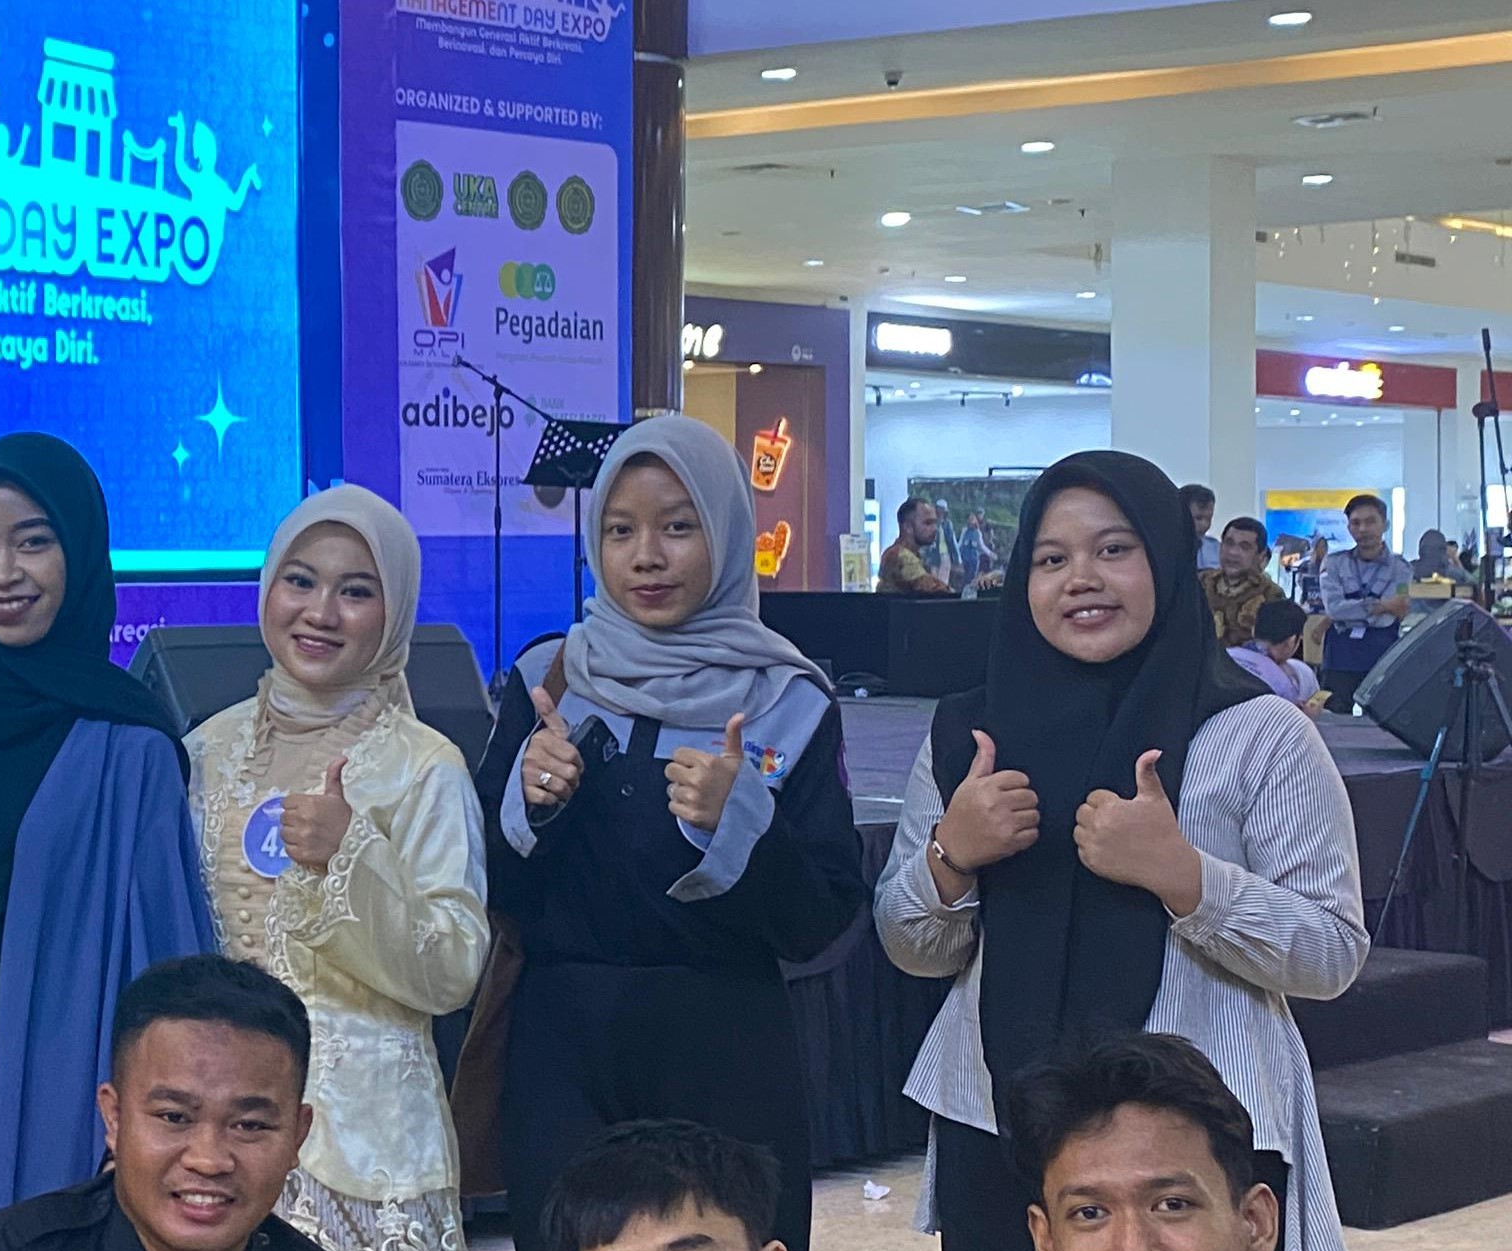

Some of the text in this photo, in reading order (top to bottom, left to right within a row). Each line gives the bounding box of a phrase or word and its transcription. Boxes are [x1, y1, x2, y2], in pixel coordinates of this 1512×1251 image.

[523, 6, 555, 30] DAY
[561, 12, 606, 37] EXPO
[395, 88, 603, 130] ORGANIZED & SUPPORTED BY:
[453, 173, 497, 199] UKA
[96, 207, 210, 271] EXPO
[43, 285, 153, 326] Berkreasi,
[413, 329, 465, 350] OPI
[496, 307, 604, 344] Pegadaian
[55, 328, 100, 365] Diri.
[413, 348, 461, 359] MAL
[401, 387, 514, 436] adibejo
[416, 470, 474, 490] Sumatera
